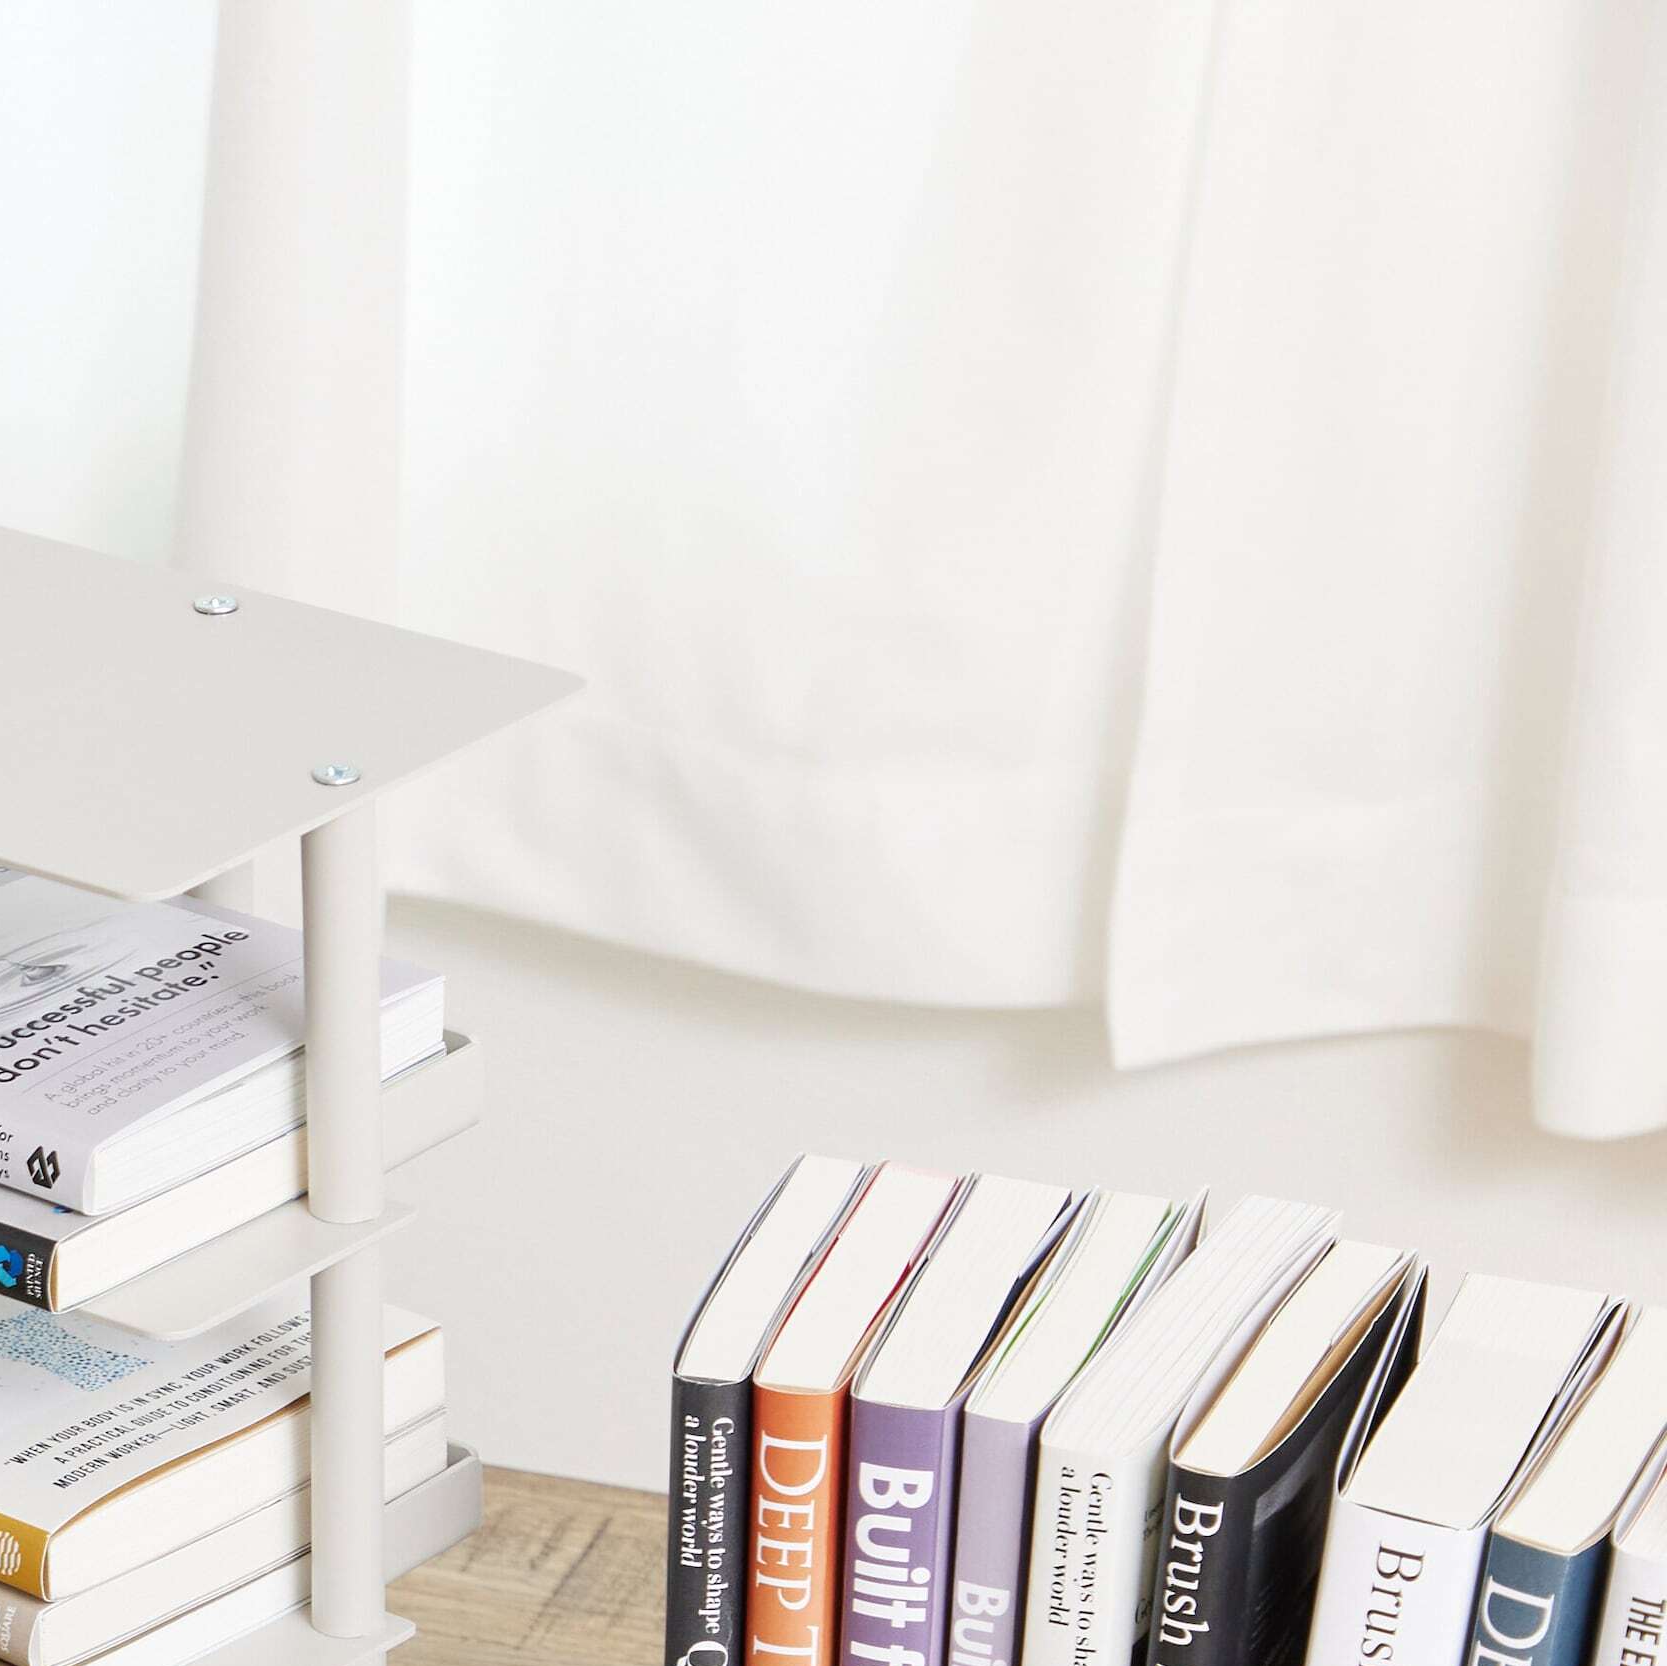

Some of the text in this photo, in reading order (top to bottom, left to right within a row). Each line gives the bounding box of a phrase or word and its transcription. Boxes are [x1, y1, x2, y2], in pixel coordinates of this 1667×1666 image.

[134, 927, 250, 981] people
[680, 1415, 707, 1568] a louder world
[698, 1416, 734, 1634] Gentle ways to shape
[755, 1430, 828, 1611] DEEP
[851, 1462, 935, 1629] Built
[0, 1604, 17, 1654] SQUARE
[1160, 1493, 1225, 1646] Brush
[1625, 1596, 1667, 1646] THE
